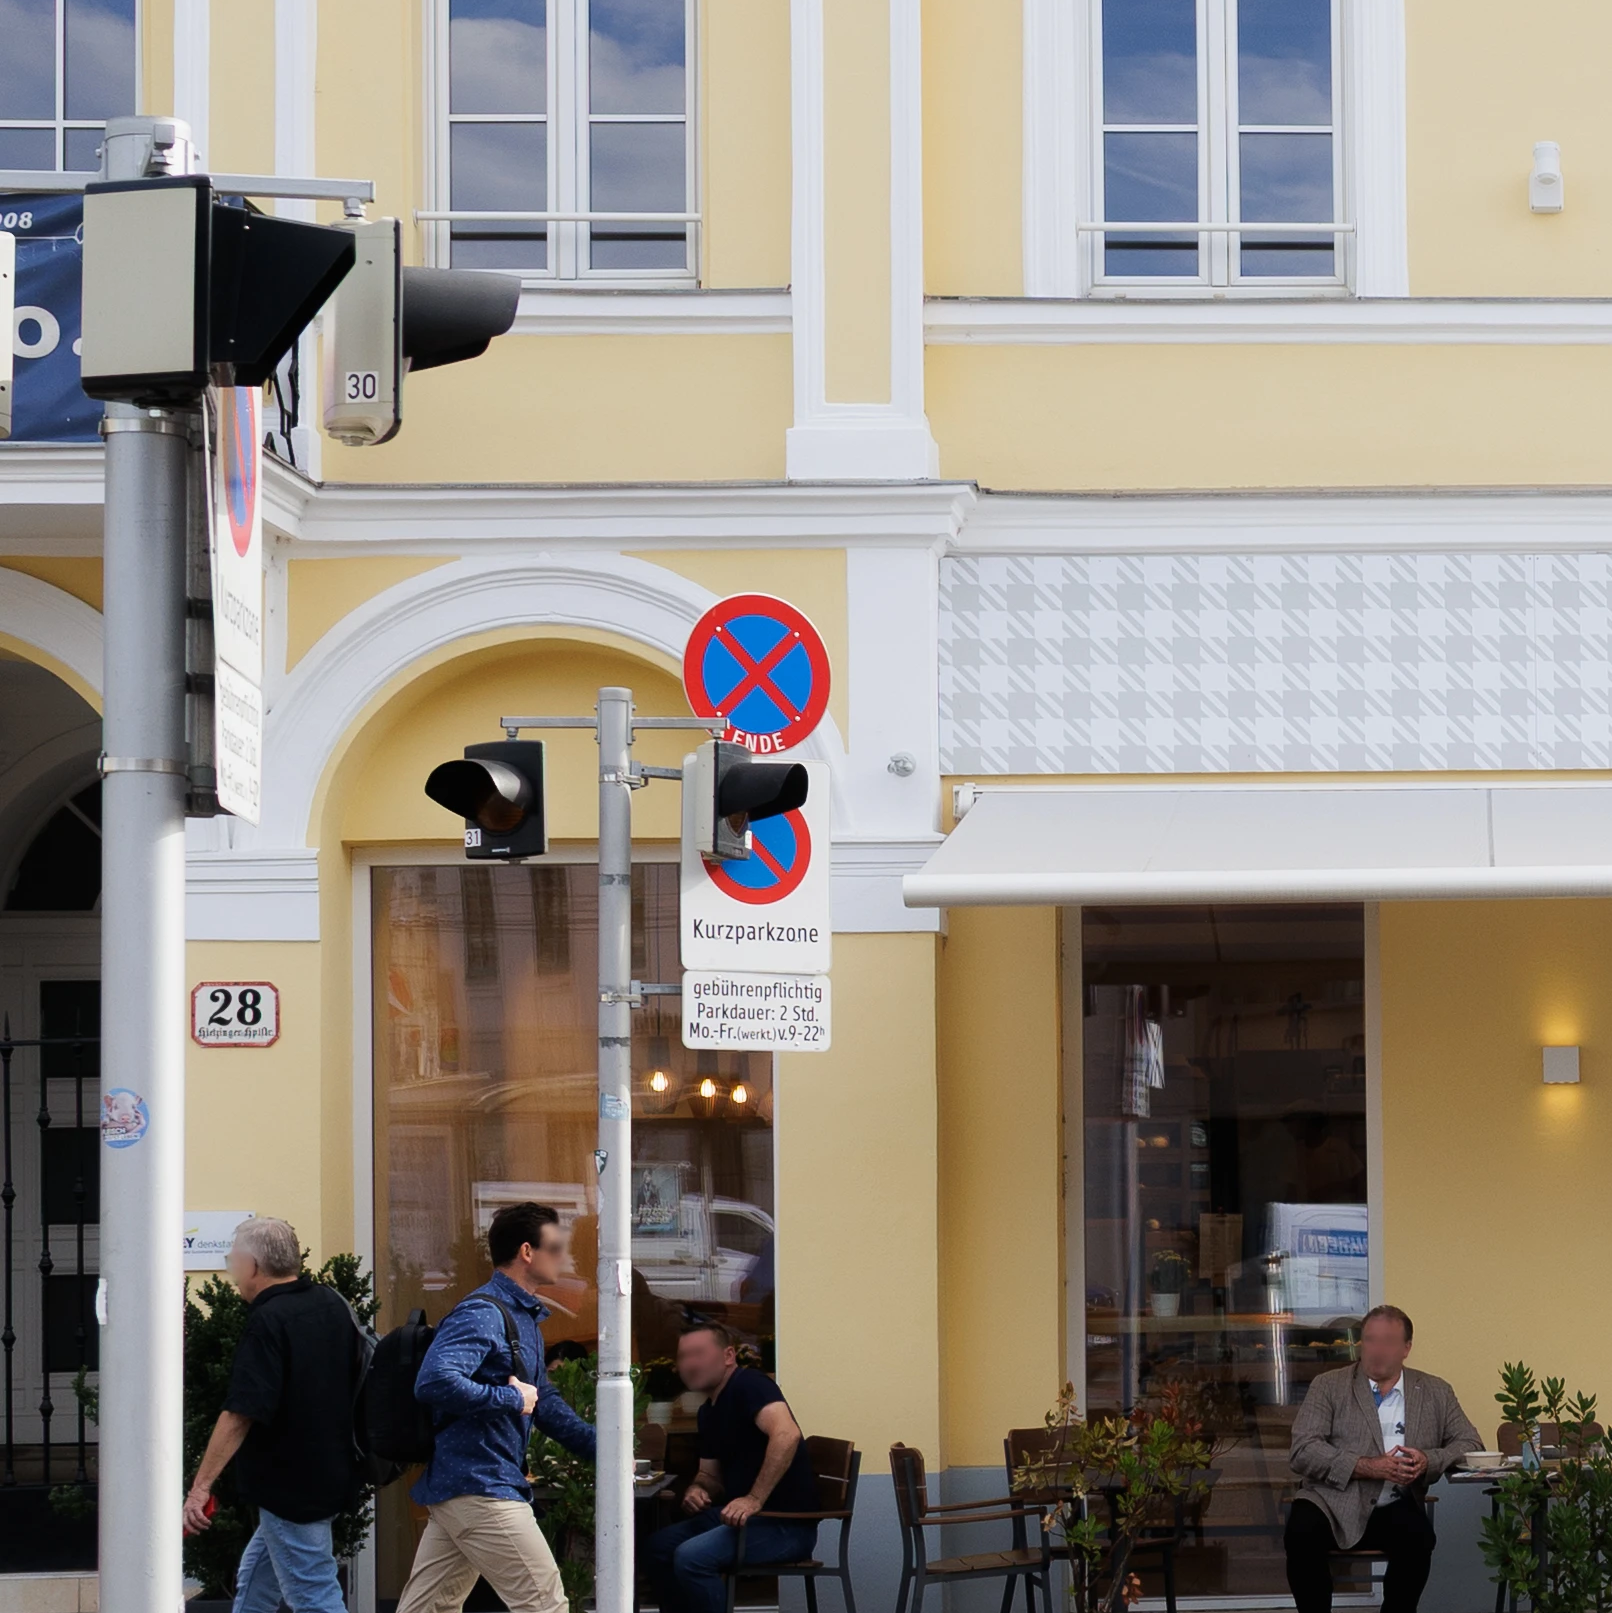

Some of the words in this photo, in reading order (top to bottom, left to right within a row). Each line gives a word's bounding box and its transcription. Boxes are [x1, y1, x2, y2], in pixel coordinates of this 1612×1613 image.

[0, 212, 33, 229] 08
[347, 374, 377, 399] 30
[732, 729, 786, 753] ENDE
[466, 830, 479, 846] 31
[692, 918, 819, 944] Kurzparkzone
[693, 980, 822, 1003] gebührenpflichtig
[208, 988, 262, 1026] 28
[697, 1002, 775, 1020] Parkdauer:
[780, 1005, 788, 1021] 2
[793, 1006, 819, 1022] Std.
[184, 1238, 195, 1248] Y
[197, 1240, 234, 1249] denksta
